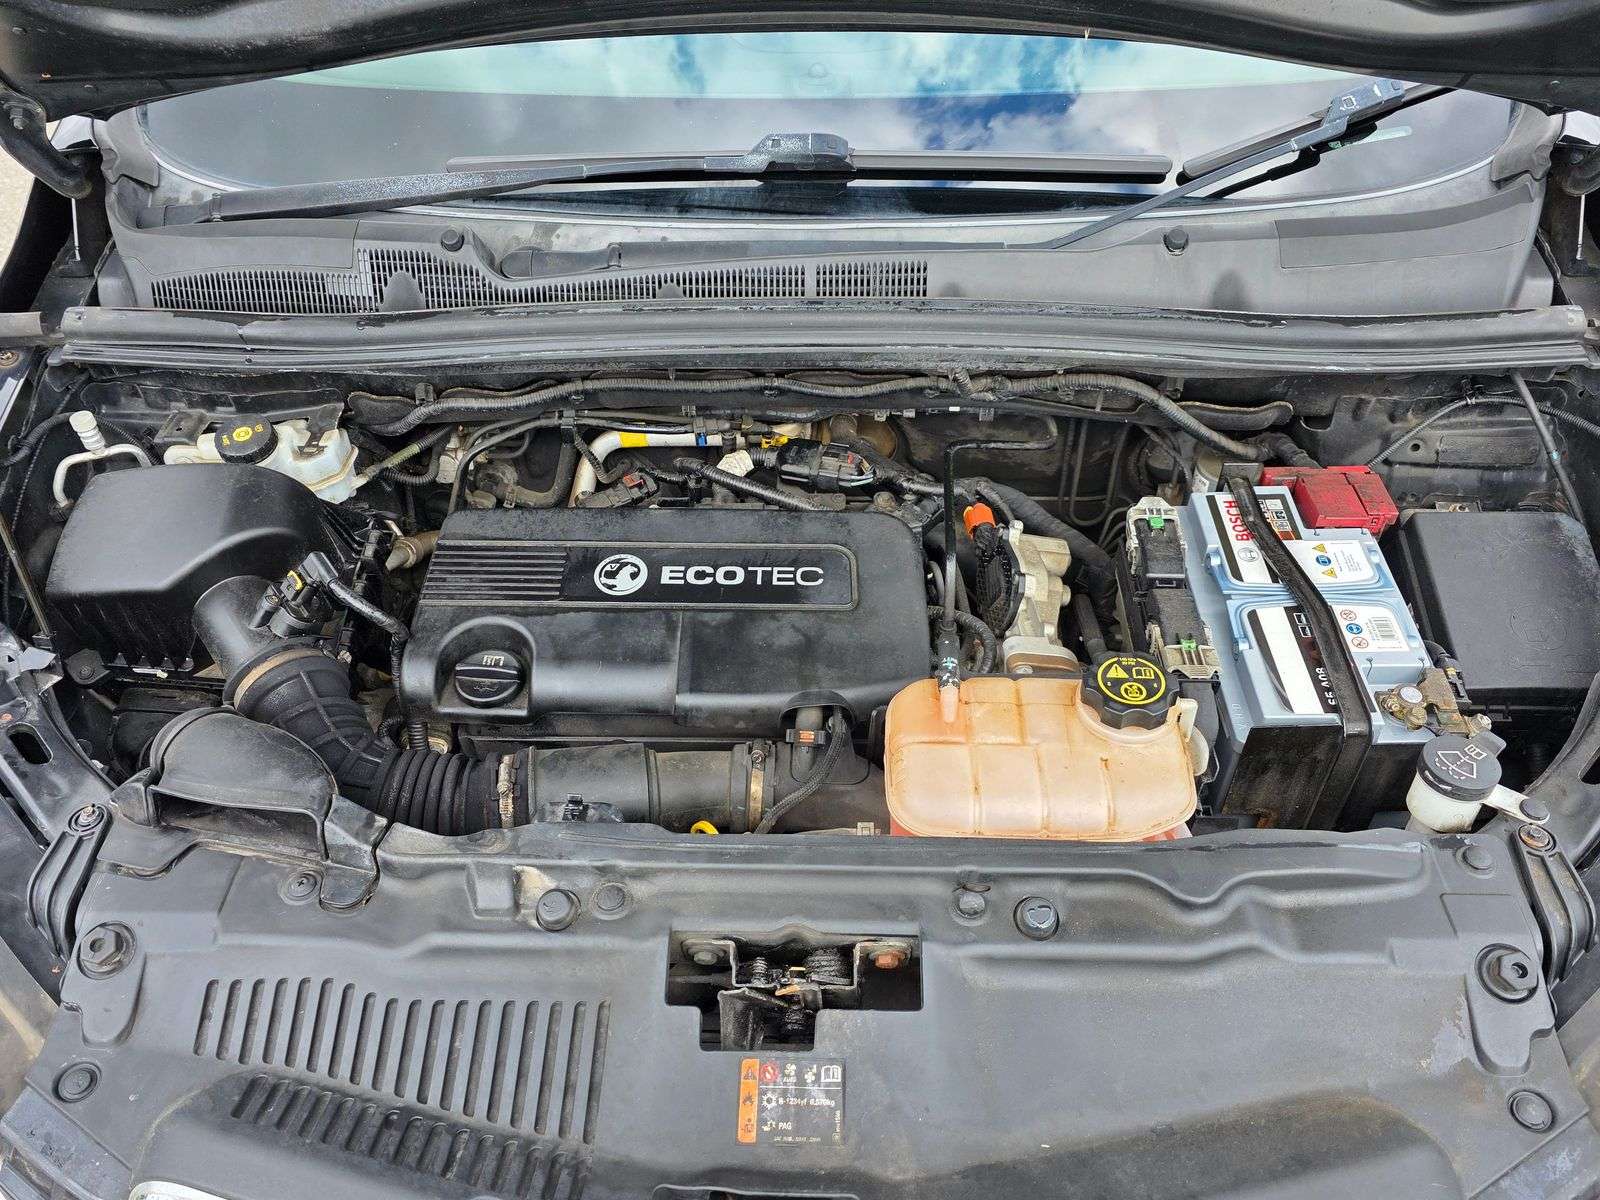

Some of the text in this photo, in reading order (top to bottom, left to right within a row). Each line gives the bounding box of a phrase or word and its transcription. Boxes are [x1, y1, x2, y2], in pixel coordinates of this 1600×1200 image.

[1224, 500, 1253, 541] BOSCH
[660, 565, 824, 586] ECOTEC
[778, 1122, 792, 1130] PAG
